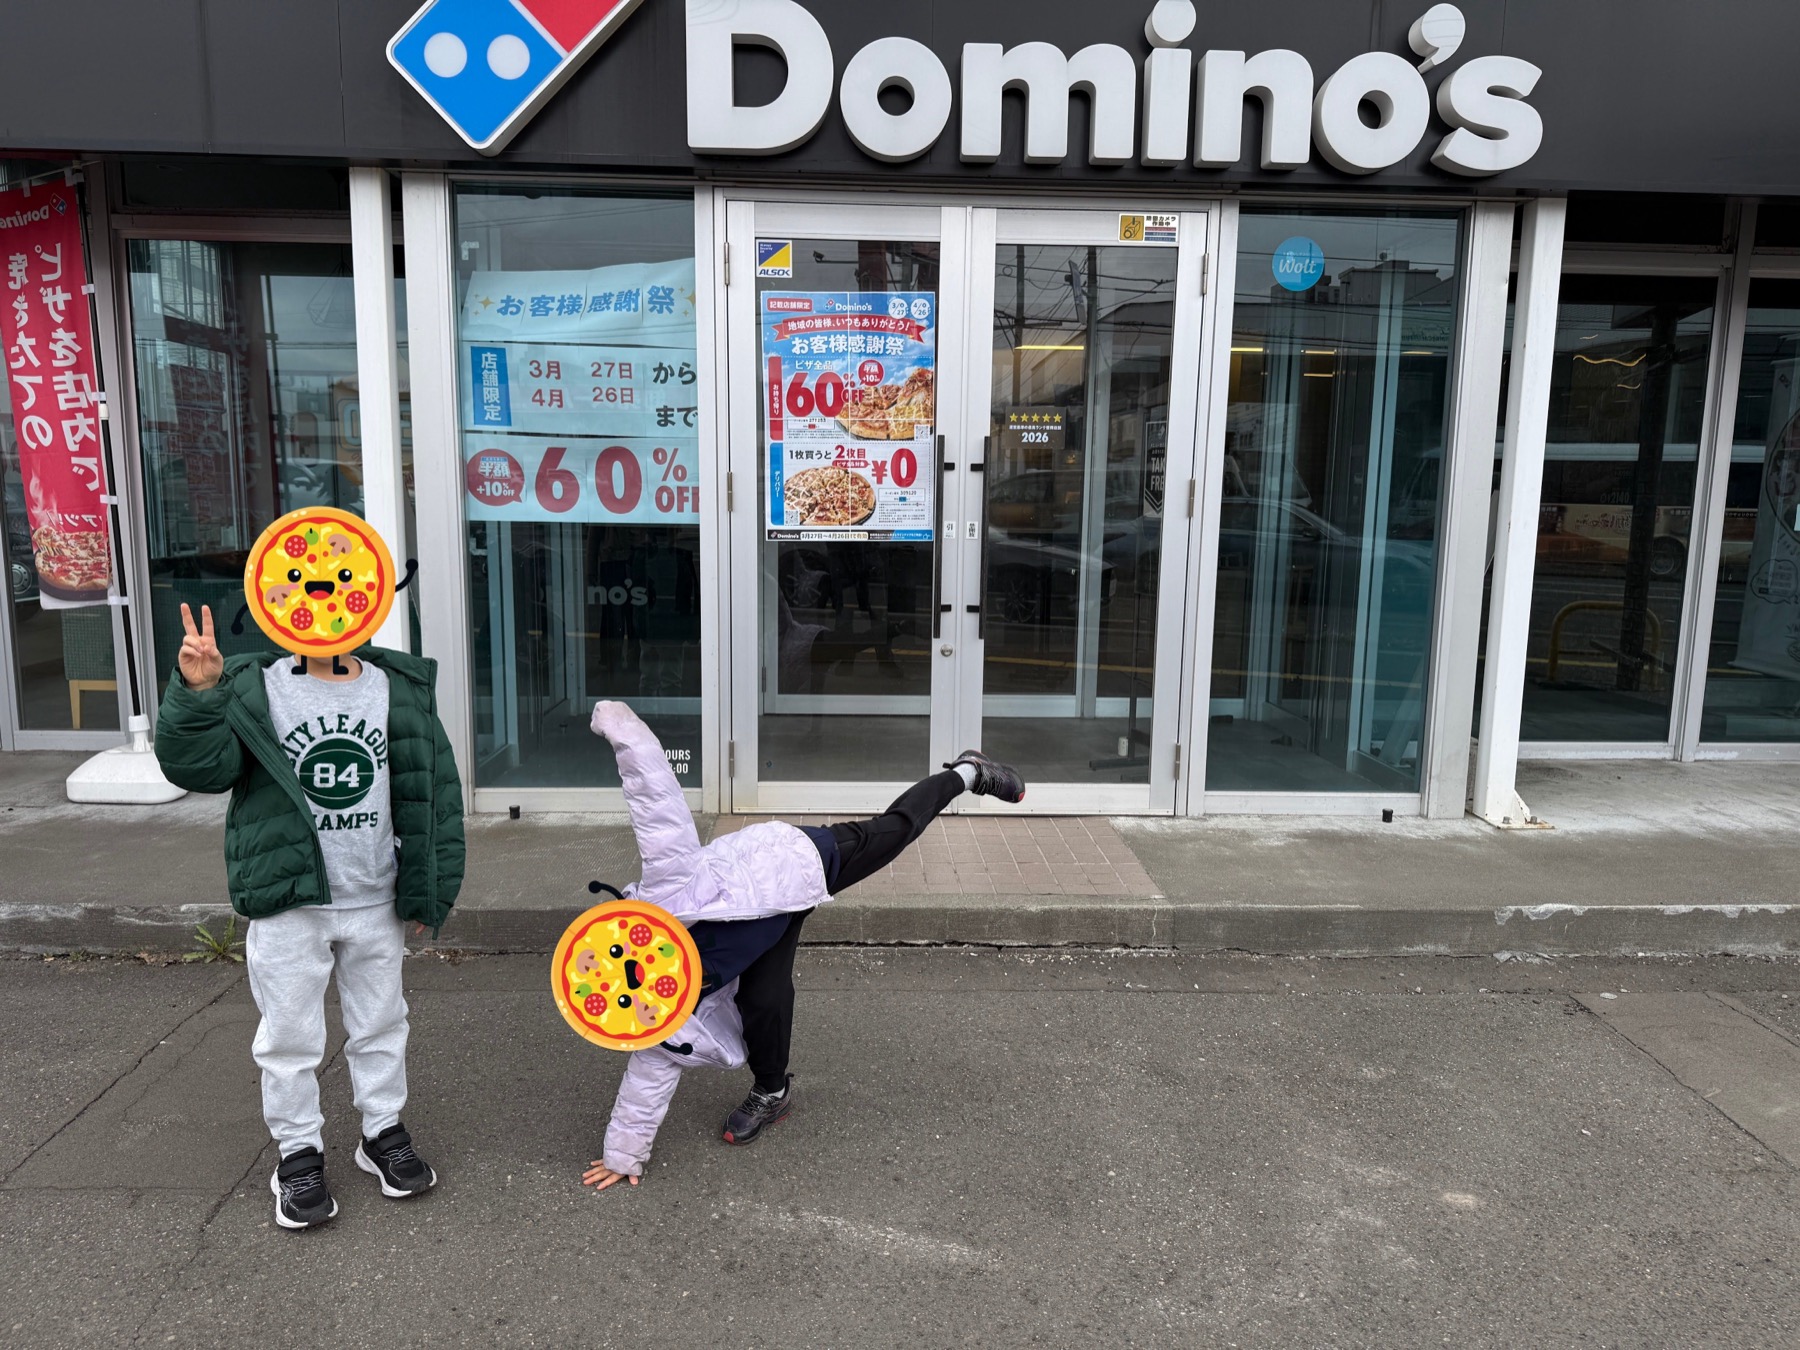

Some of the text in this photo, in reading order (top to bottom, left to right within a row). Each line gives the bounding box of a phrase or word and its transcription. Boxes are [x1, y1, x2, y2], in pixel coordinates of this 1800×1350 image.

[686, 0, 1543, 174] Domino's
[758, 268, 791, 277] ALSOK
[1279, 259, 1317, 274] Wolt
[496, 285, 676, 318] お客様感謝祭
[836, 302, 873, 311] Domino's
[792, 334, 905, 356] お客様感謝祭
[529, 360, 697, 385] 3月 27日 から
[795, 360, 833, 371] ピザ全品
[481, 351, 502, 422] 店舗限定
[531, 386, 635, 408] 4月 26日
[841, 389, 865, 403] OFF
[655, 405, 698, 429] まで
[1021, 432, 1049, 443] 2026
[789, 444, 866, 460] 1枚買うと 2枚目
[281, 713, 388, 770] ITY LEAGUE
[313, 762, 360, 788] 84
[670, 762, 689, 774] :00
[314, 811, 379, 831] AMPS
